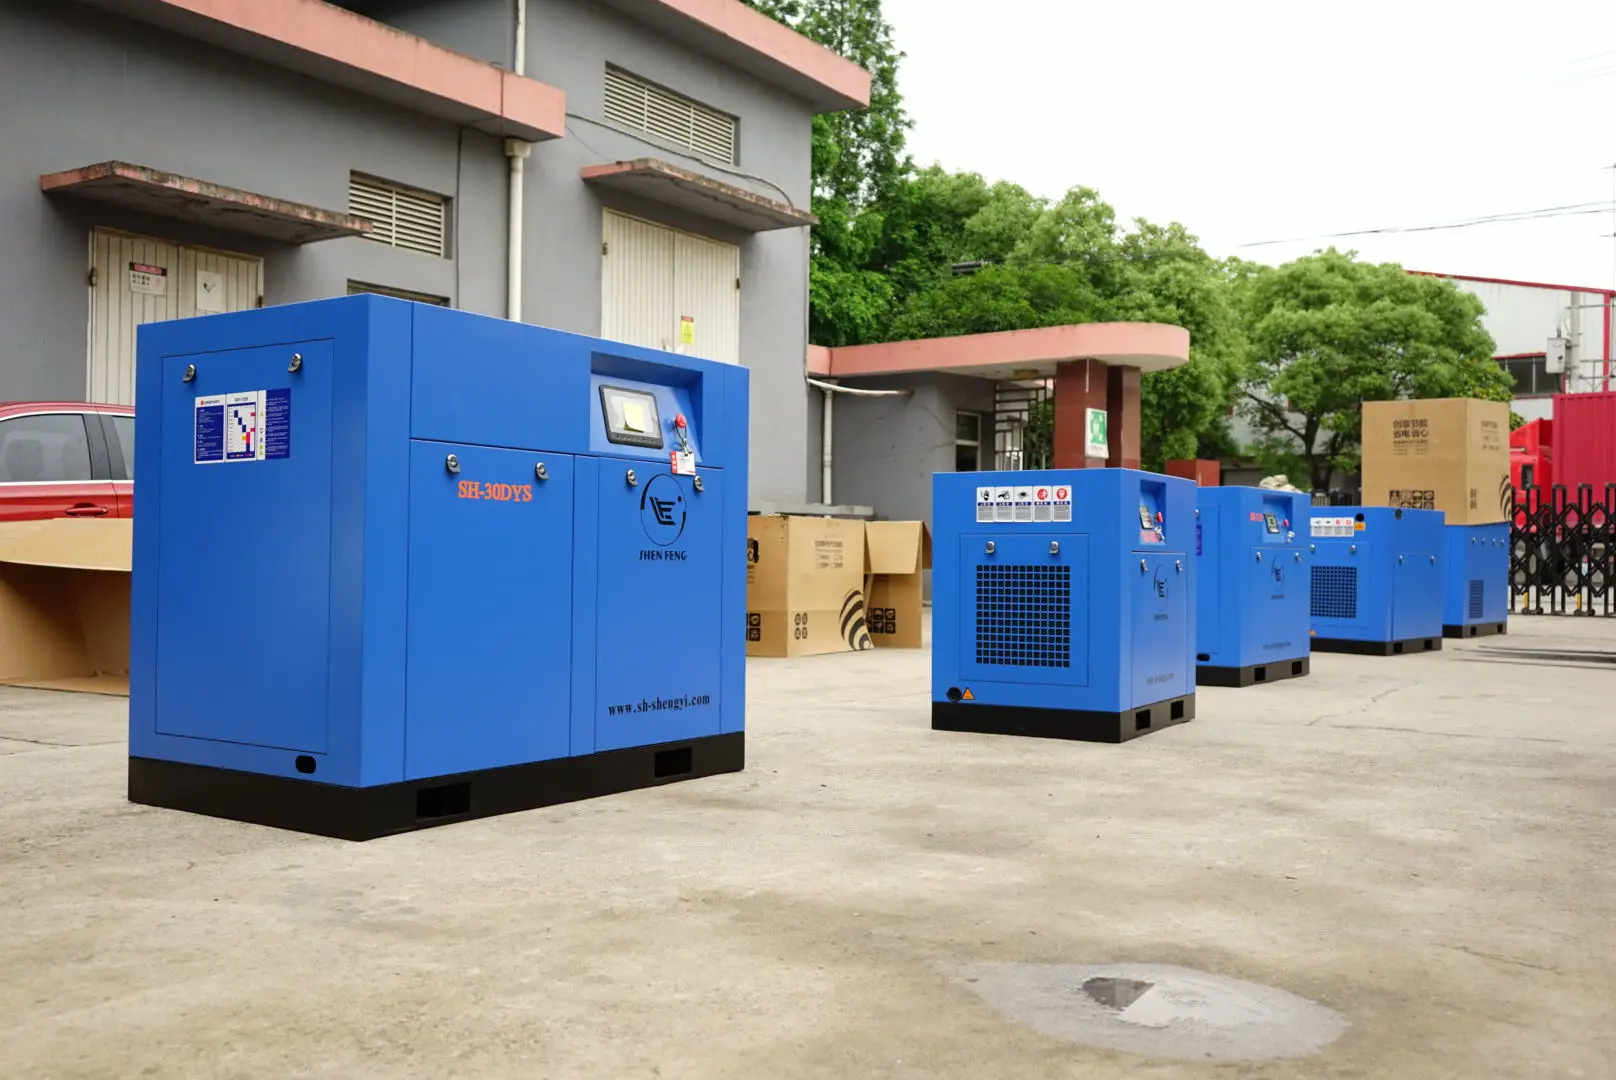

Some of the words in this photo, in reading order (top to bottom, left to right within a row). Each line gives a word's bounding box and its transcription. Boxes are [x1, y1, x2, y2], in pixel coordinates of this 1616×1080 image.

[457, 480, 533, 503] SH-30DYS
[639, 549, 662, 561] SHEN
[664, 550, 687, 561] FENG
[608, 694, 710, 717] www.sh-shengyi.com
